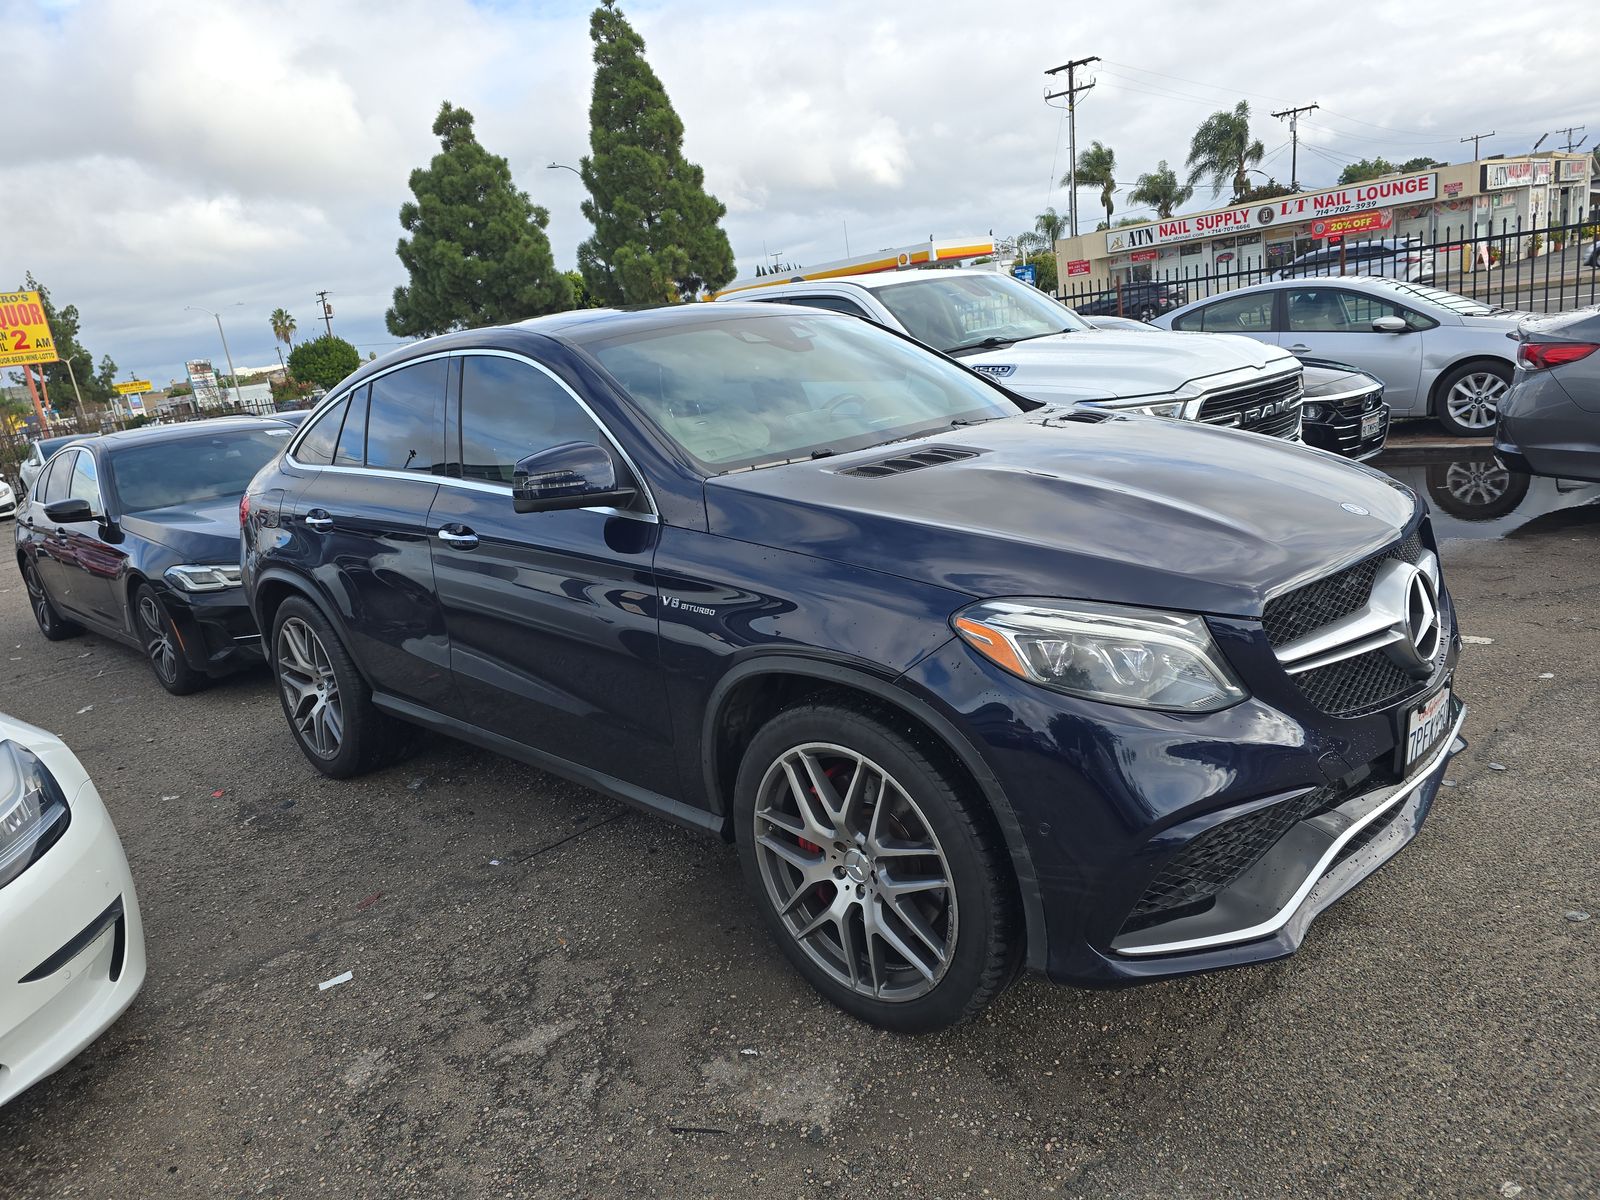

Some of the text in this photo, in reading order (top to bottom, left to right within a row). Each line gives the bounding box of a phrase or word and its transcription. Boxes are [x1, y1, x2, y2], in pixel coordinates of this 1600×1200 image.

[1313, 191, 1351, 210] NAIL
[1357, 177, 1429, 202] LOUNGE
[1315, 201, 1377, 217] 714-702-3939
[1128, 209, 1250, 247] ATN NAIL SUPPLY
[1330, 220, 1352, 232] 20%
[1353, 217, 1372, 228] OFF
[10, 330, 30, 350] 2
[36, 337, 51, 349] AM
[1244, 399, 1290, 423] RAM
[662, 595, 716, 616] V8 BITURBO
